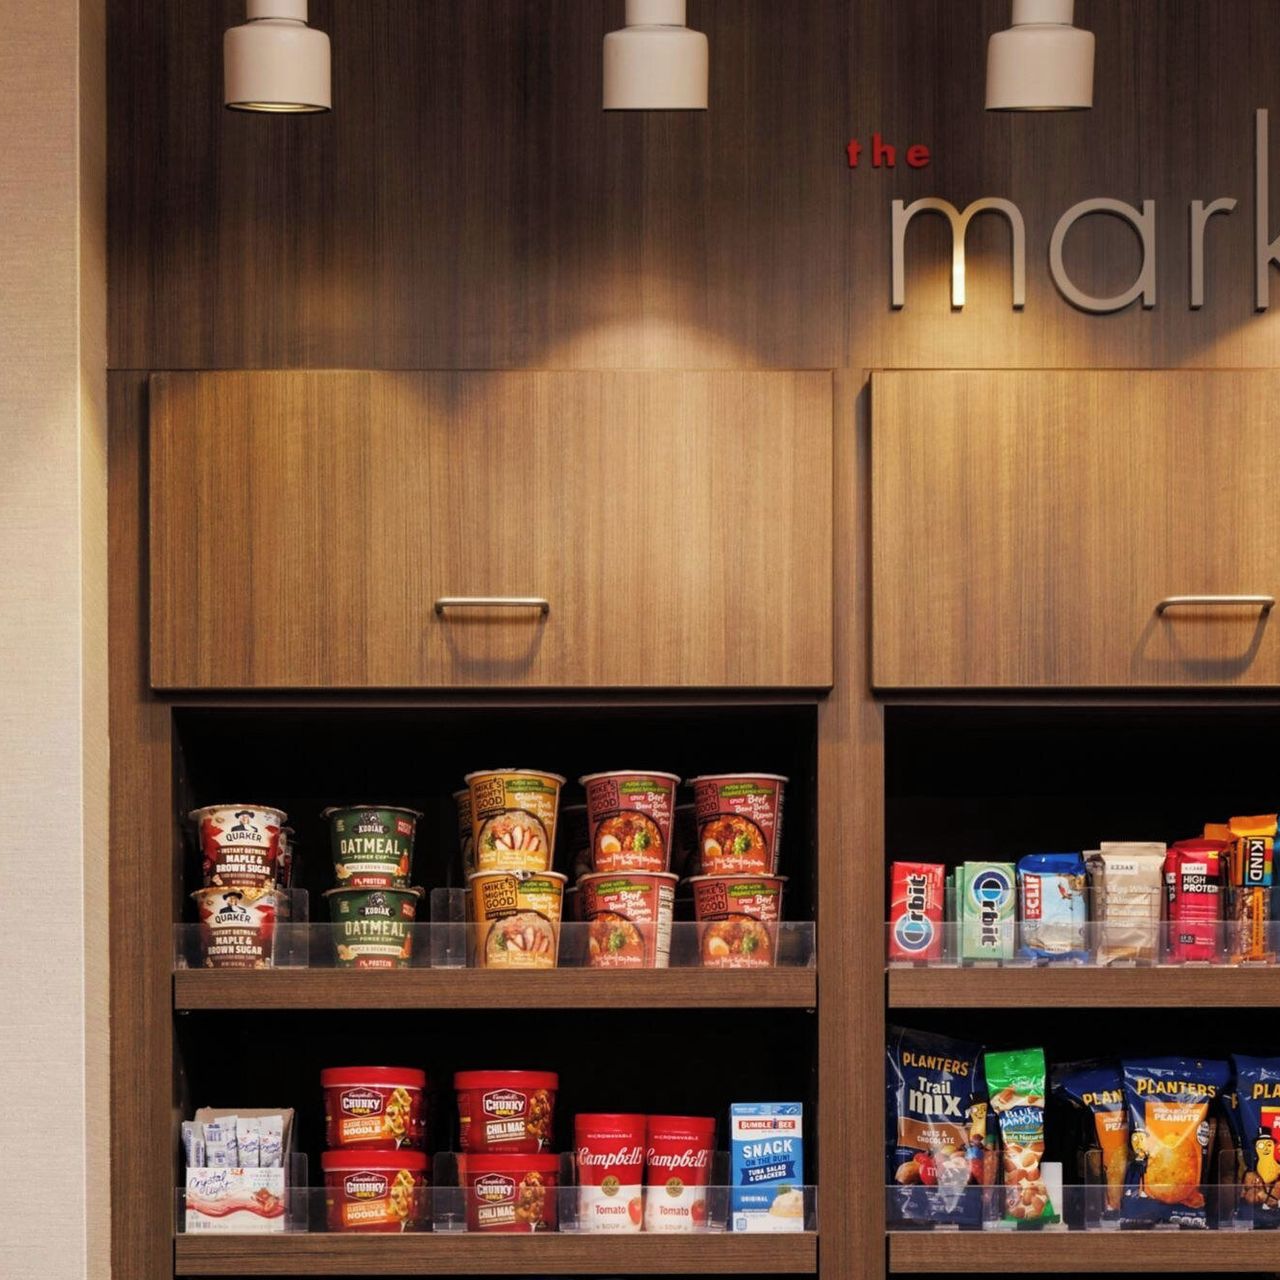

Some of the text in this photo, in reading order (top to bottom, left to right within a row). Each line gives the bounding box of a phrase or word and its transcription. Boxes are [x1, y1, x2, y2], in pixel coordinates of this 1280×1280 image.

[847, 133, 931, 167] the
[226, 831, 262, 843] QUAKER
[340, 838, 400, 854] OATMEAL
[226, 854, 254, 864] MAPLE
[1249, 839, 1263, 881] KIND
[216, 863, 271, 875] BROWN SUGAR
[1183, 875, 1207, 885] HIGH
[1025, 875, 1040, 908] CLIF
[1182, 883, 1219, 893] PROTEIN
[486, 896, 515, 909] GOOD
[215, 912, 252, 924] QUAKER
[345, 920, 405, 937] OATMEAL
[903, 1051, 969, 1077] PLANTERS
[918, 1076, 951, 1094] Trail
[1136, 1079, 1216, 1098] PLANTERS
[343, 1098, 380, 1109] CHUNKY
[486, 1099, 524, 1112] CHUNKY
[909, 1089, 961, 1118] mix
[1154, 1113, 1200, 1122] PEANUTS
[343, 1125, 381, 1135] NOODLE
[486, 1121, 525, 1135] CHILI MAC
[740, 1120, 771, 1130] BUMBLE
[922, 1129, 940, 1137] NUTS
[917, 1136, 955, 1144] CHOCOLATE
[743, 1140, 793, 1158] SNACK
[578, 1147, 642, 1166] Campbell's
[646, 1149, 707, 1169] Campbell's
[346, 1181, 385, 1194] CHUNKY
[477, 1184, 513, 1196] CHUNKY
[347, 1209, 387, 1220] NOODLE
[595, 1204, 626, 1216] Tomato
[659, 1204, 689, 1217] Tomato
